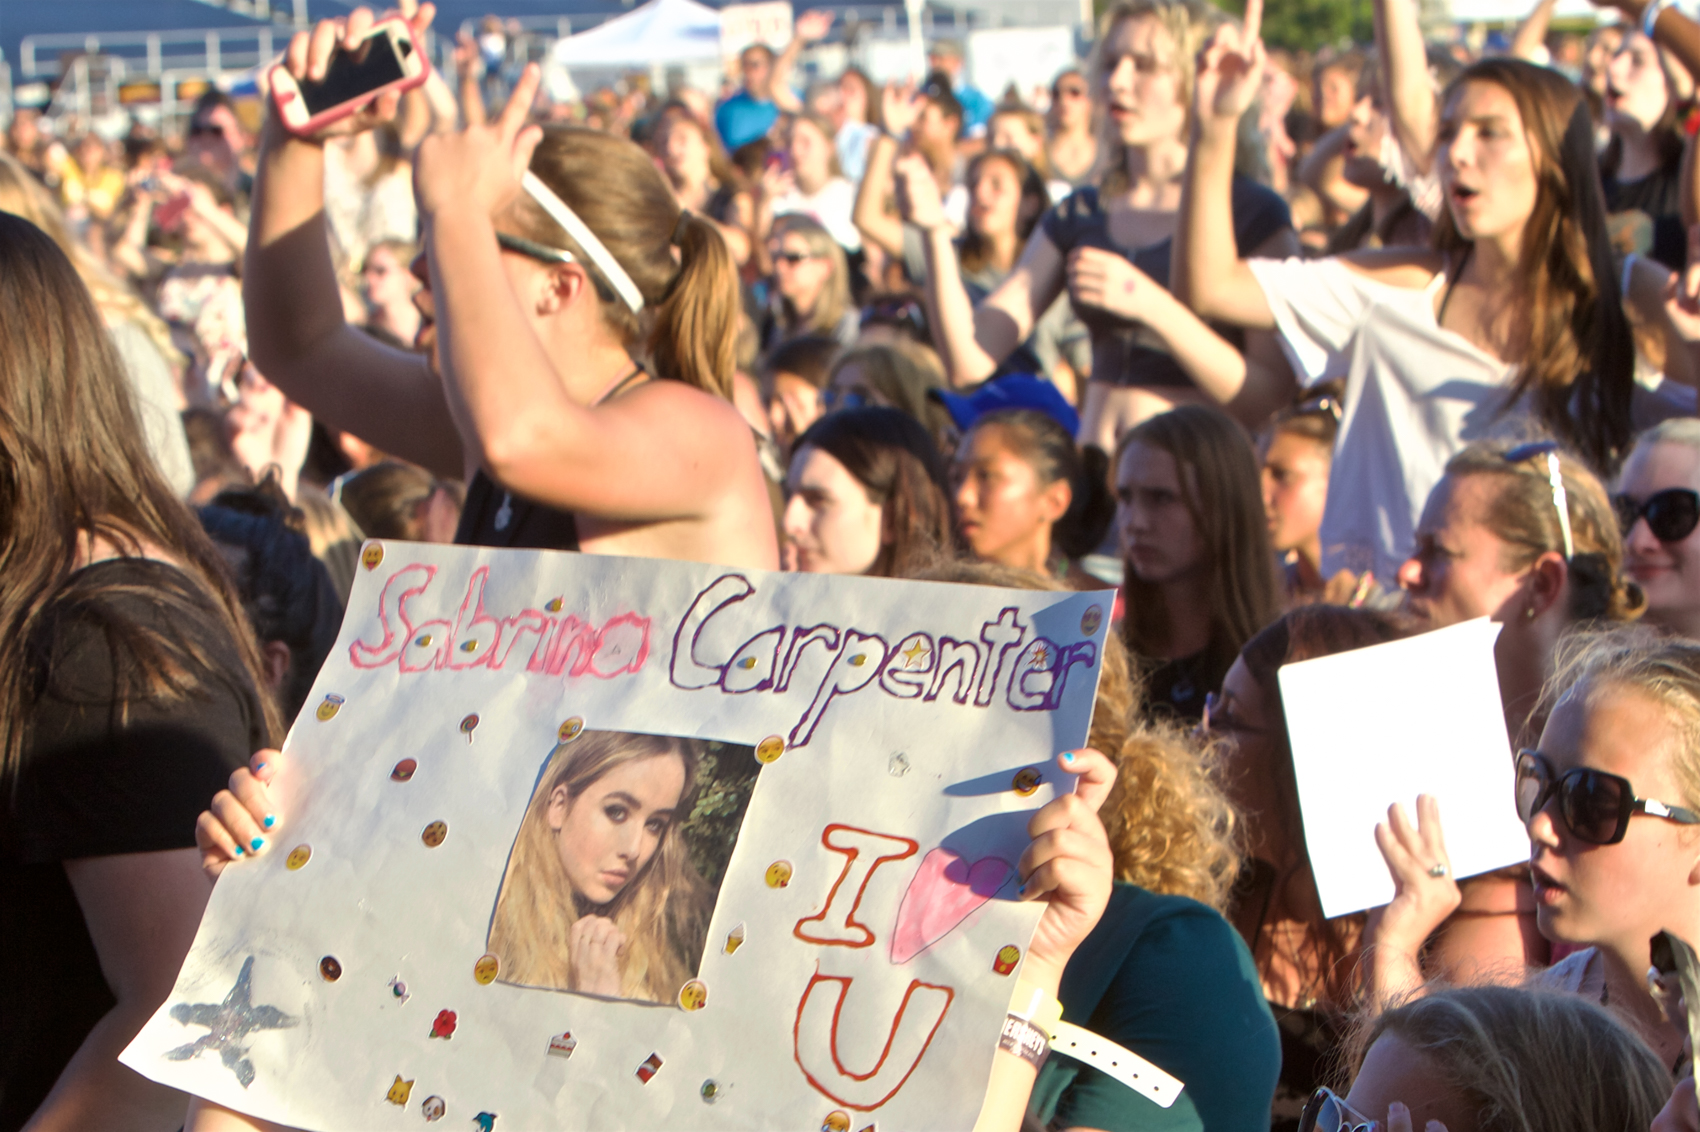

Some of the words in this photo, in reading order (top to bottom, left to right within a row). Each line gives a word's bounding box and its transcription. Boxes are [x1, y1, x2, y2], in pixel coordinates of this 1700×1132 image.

[349, 563, 652, 679] Sabrina
[669, 573, 1097, 750] Carpenter
[793, 823, 919, 948] I
[793, 968, 955, 1112] U
